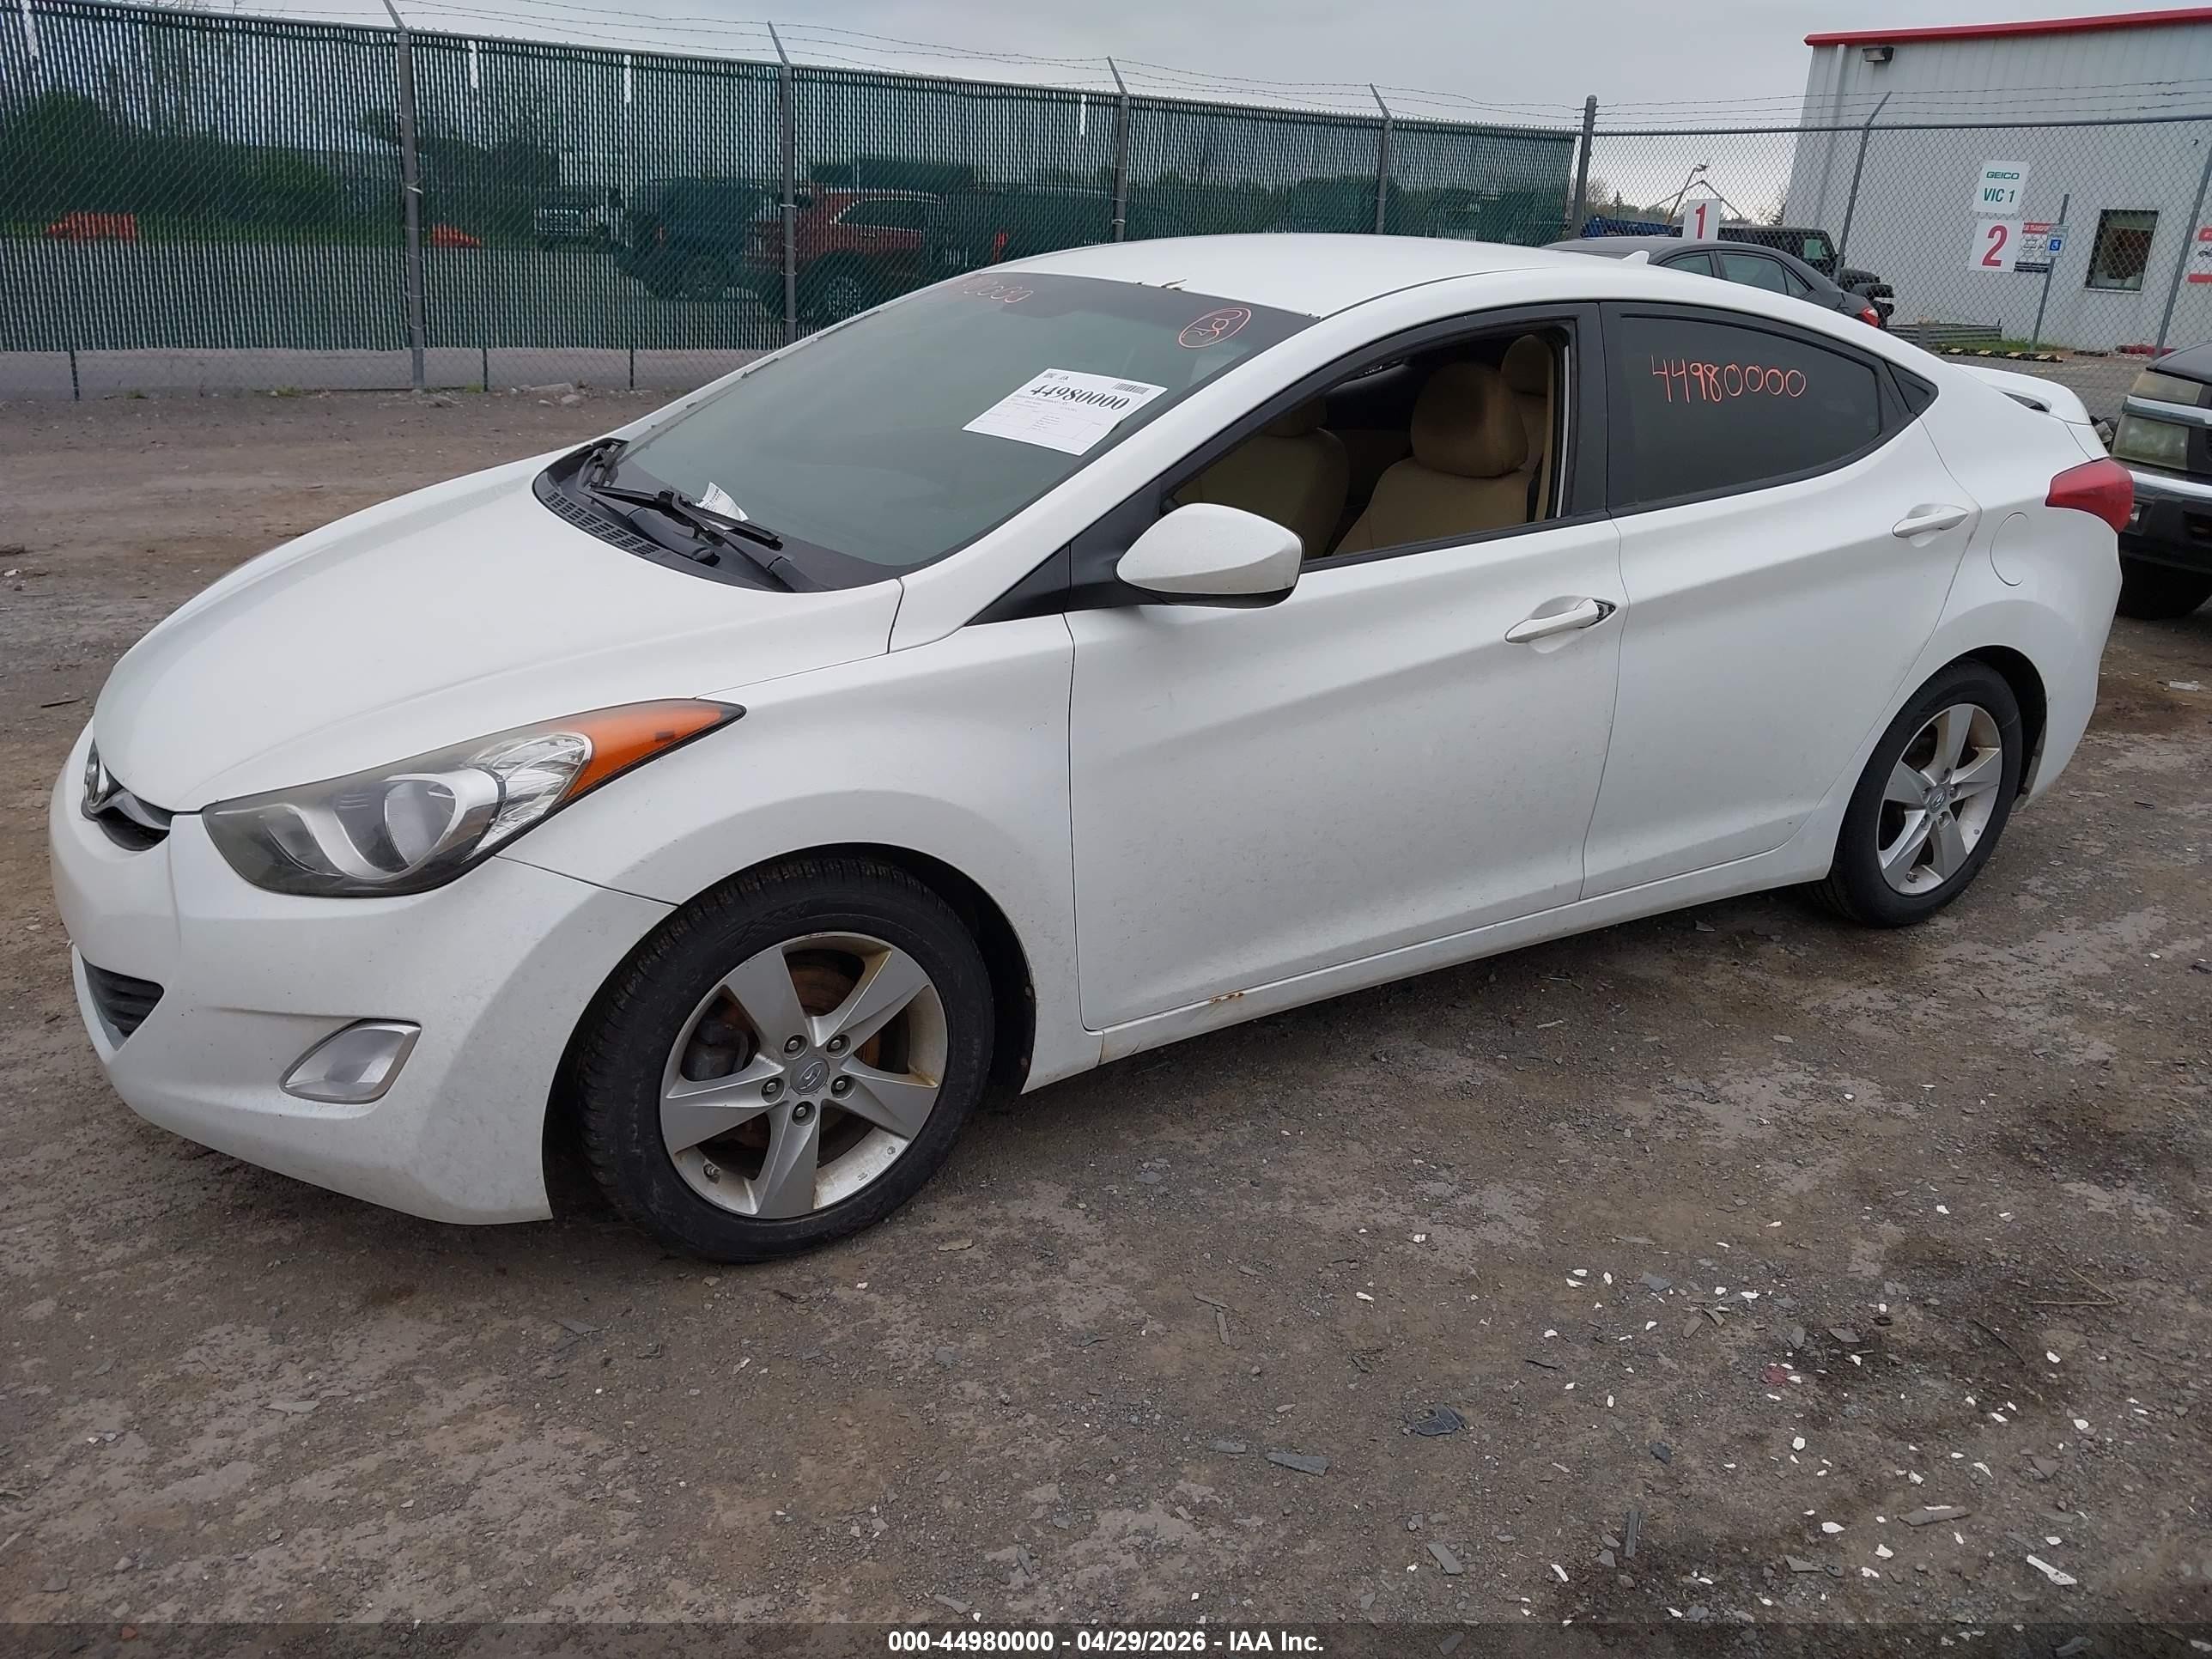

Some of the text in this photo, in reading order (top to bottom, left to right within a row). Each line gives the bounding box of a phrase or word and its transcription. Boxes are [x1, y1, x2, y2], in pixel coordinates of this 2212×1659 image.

[1986, 171, 2020, 179] GEICO
[1984, 187, 2015, 203] VIC 1
[1695, 203, 1706, 239] 1
[1981, 224, 2008, 267] 2
[1650, 354, 1807, 404] 44980000
[1030, 384, 1131, 410] 44980000
